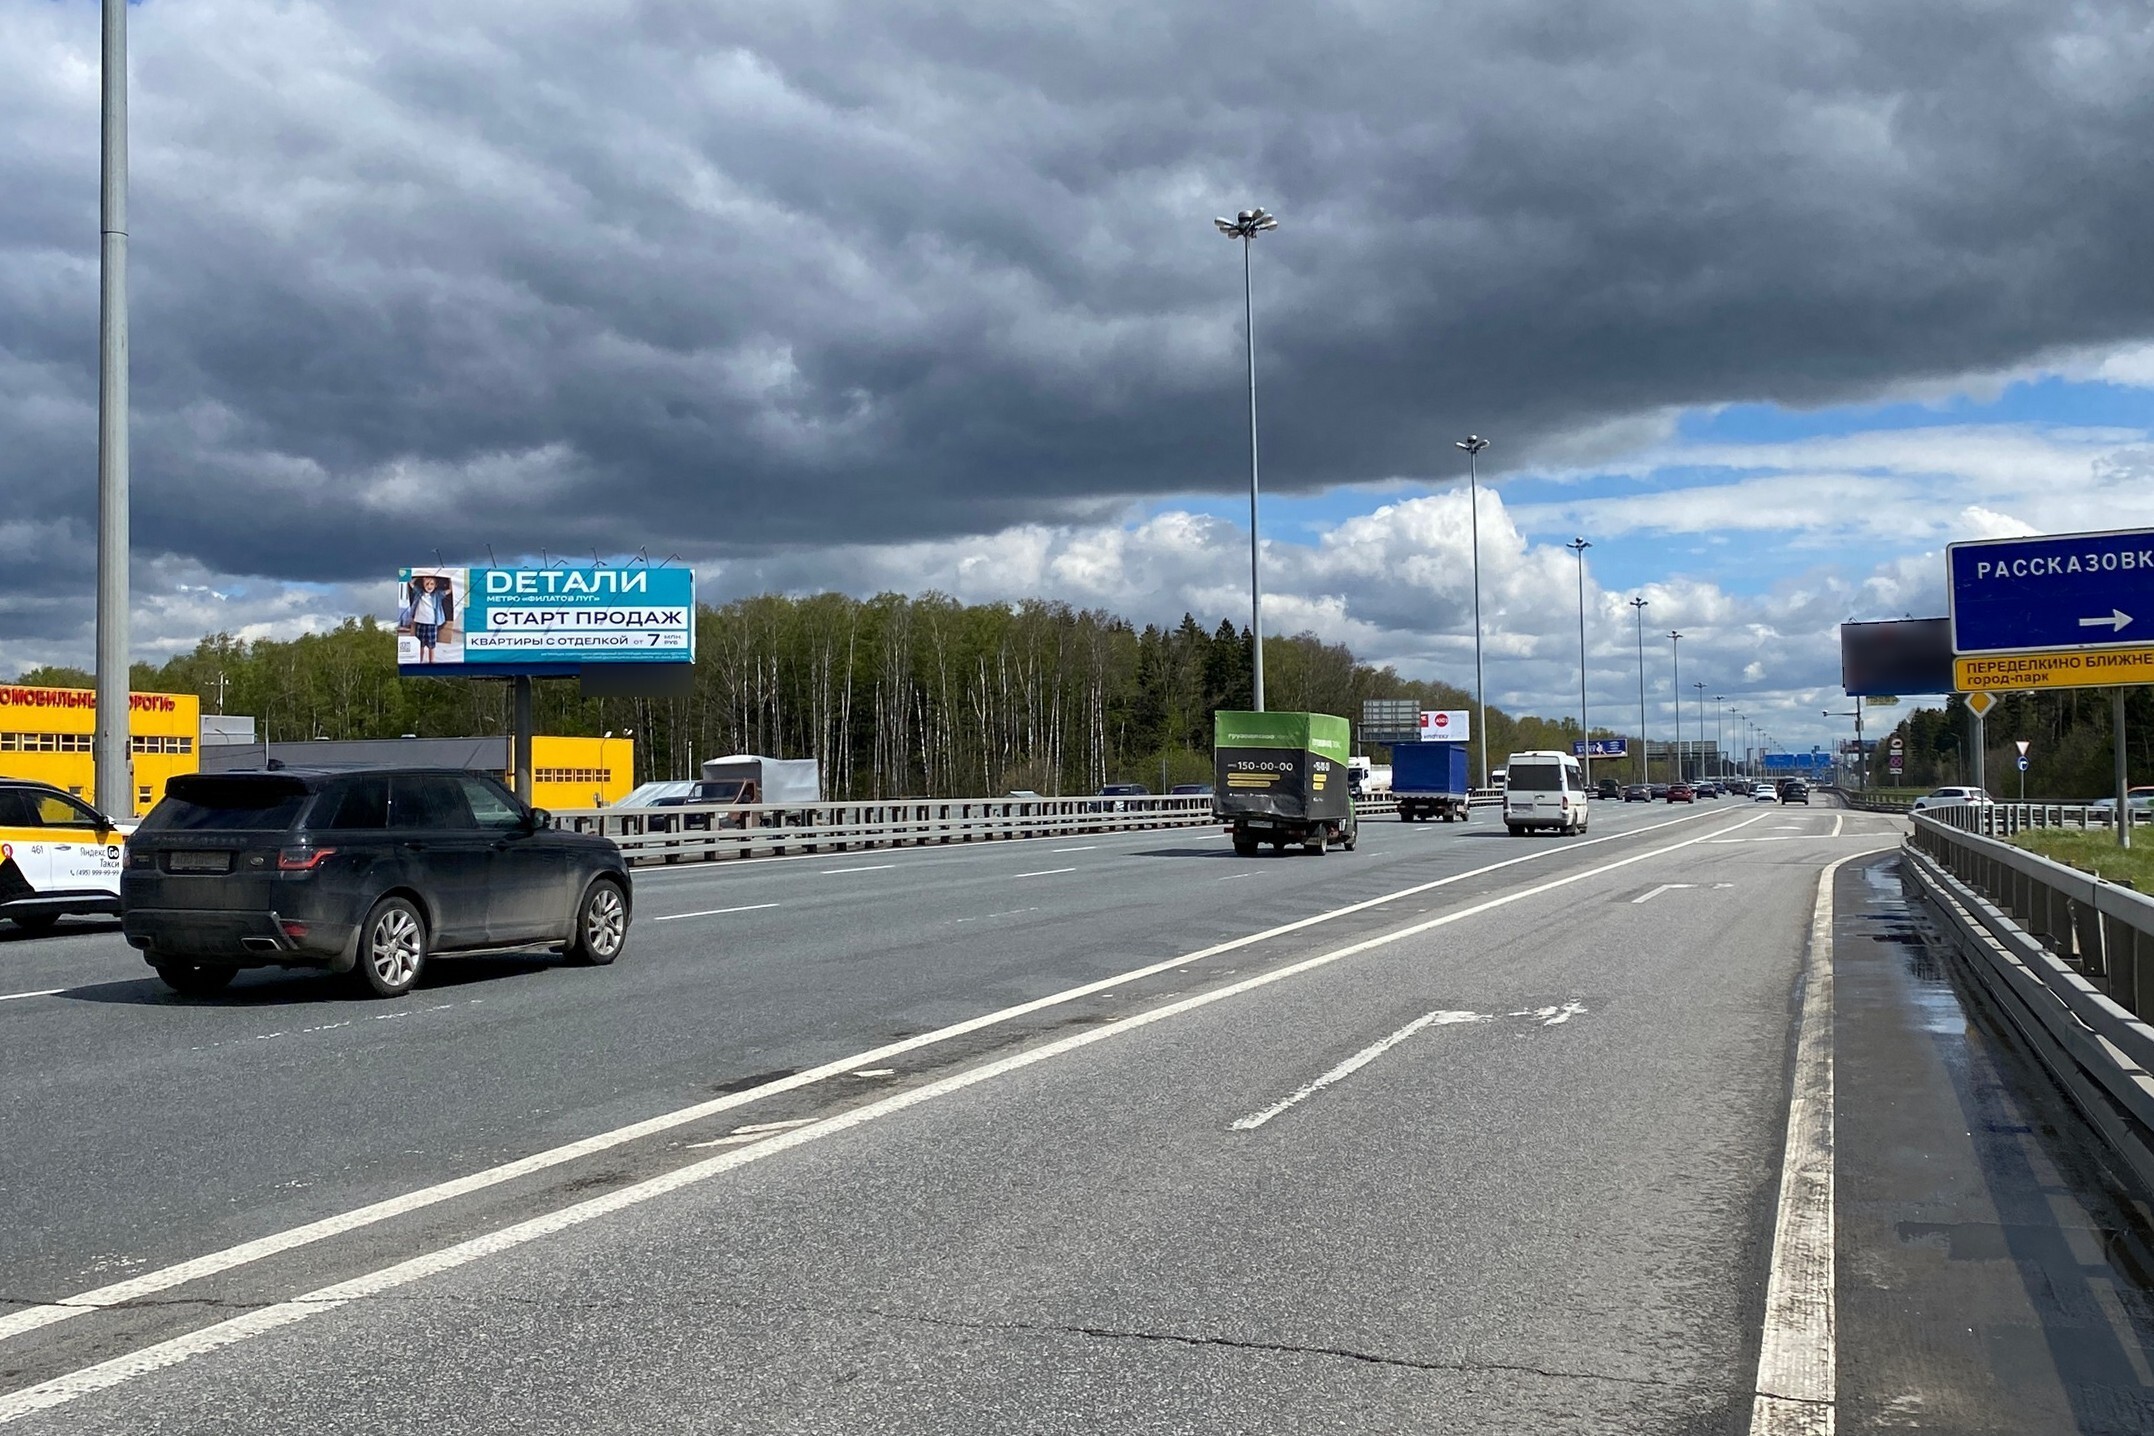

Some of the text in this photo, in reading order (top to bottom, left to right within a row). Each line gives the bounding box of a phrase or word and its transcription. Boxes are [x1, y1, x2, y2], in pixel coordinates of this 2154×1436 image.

[1977, 550, 2154, 579] РАССКАЗОВК
[492, 611, 682, 626] СТАРТ ПРОДАЖ
[471, 637, 543, 646] КВАРТИРЫ
[546, 637, 555, 645] С
[557, 635, 628, 646] ОТДЕЛКОЙ
[647, 634, 660, 646] 7
[1967, 653, 2153, 674] ПЕРЕДЕЛКИНО БЛИЖНЕ
[1967, 672, 2049, 687] город-парк
[1237, 761, 1294, 771] 150-00-00
[31, 845, 44, 854] 461
[80, 846, 119, 858] Яндекс Go
[100, 858, 119, 868] Такси
